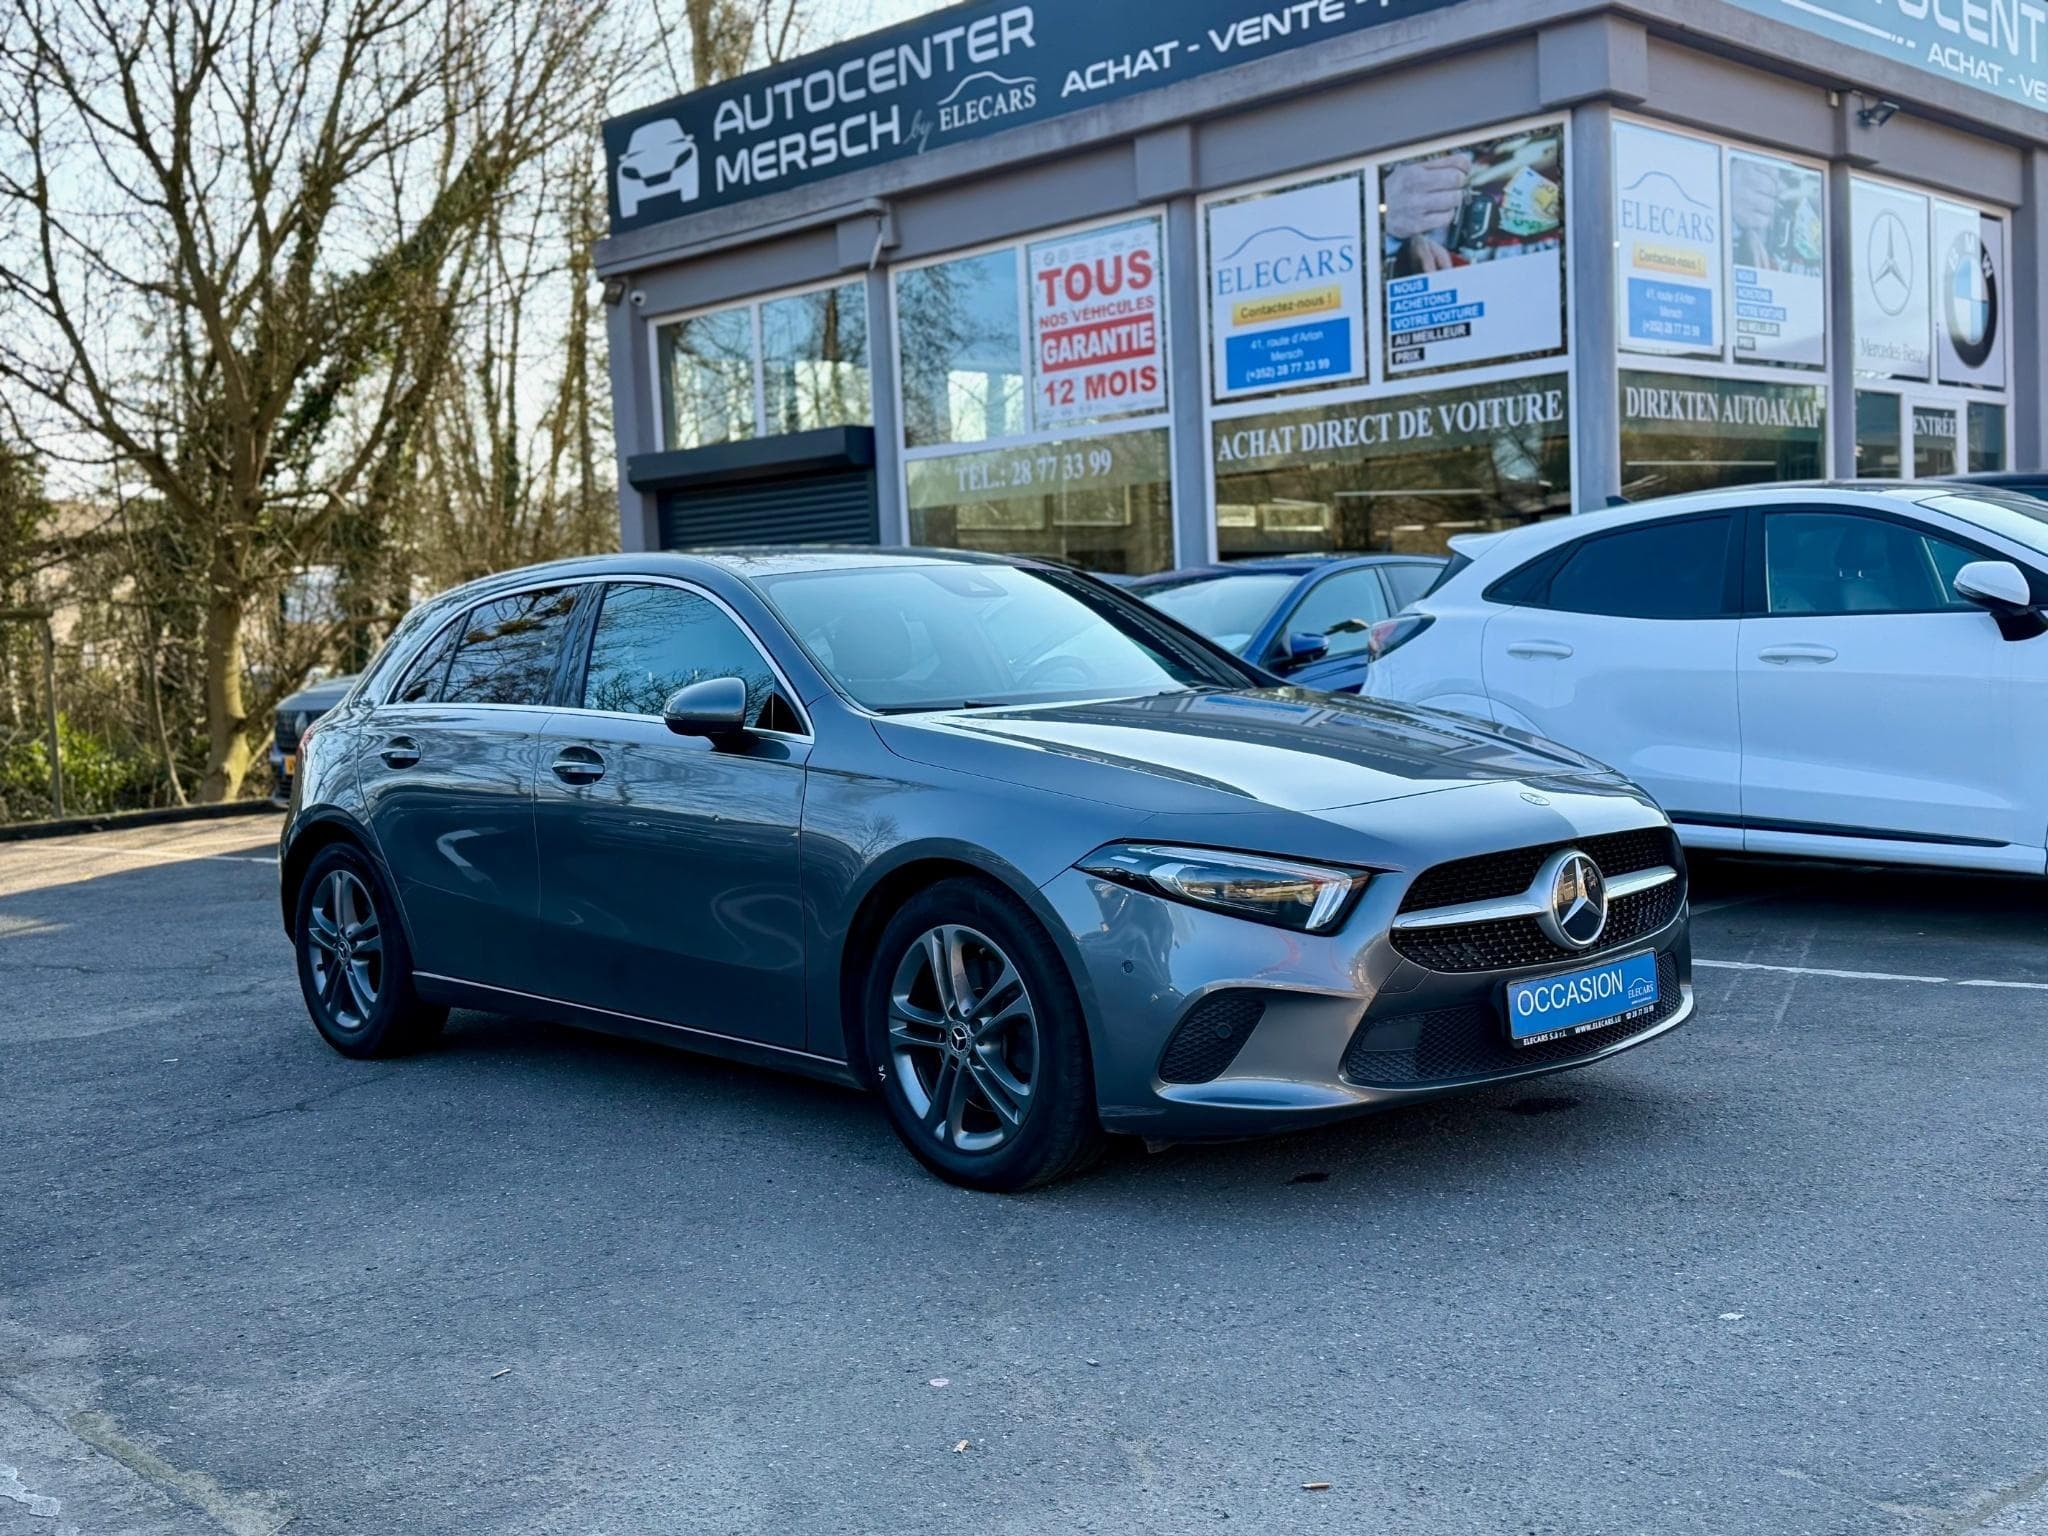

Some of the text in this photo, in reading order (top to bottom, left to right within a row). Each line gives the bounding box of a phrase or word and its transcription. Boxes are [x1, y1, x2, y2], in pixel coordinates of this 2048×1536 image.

[1061, 41, 1179, 98] ACHAT
[1208, 0, 1345, 52] VENTE
[1874, 0, 2046, 63] CENT
[714, 6, 1036, 142] AUTOCENTER
[1927, 42, 2003, 86] ACHAT
[716, 83, 1037, 193] MERSCH by ELECARS
[1621, 199, 1715, 243] ELECARS
[1038, 249, 1152, 307] TOUS
[1217, 244, 1355, 296] ELECARS
[1393, 279, 1424, 295] NOUS
[1039, 312, 1068, 328] NOS
[1240, 295, 1325, 319] Contactez-nous
[1394, 292, 1453, 313] ACHETONS
[1394, 304, 1480, 329] VOTRE VOITURE
[1042, 323, 1154, 366] GARANTIE
[1395, 325, 1467, 347] AU MEILLEUR
[1395, 349, 1420, 364] PRIX
[1044, 367, 1157, 407] 12 MOIS
[1217, 389, 1563, 462] ACHAT DIRECT DE VOITURE
[1626, 387, 1821, 428] DIREKTEN AUTOAKAAF
[1912, 411, 1957, 438] ENTRÉE
[1011, 458, 1033, 486] 28
[1037, 455, 1058, 482] 77
[1062, 452, 1085, 480] 33
[1089, 447, 1113, 477] 99
[1517, 968, 1624, 1017] OCCASION
[1628, 983, 1654, 999] ELECARS
[1523, 1034, 1549, 1046] ELECARS
